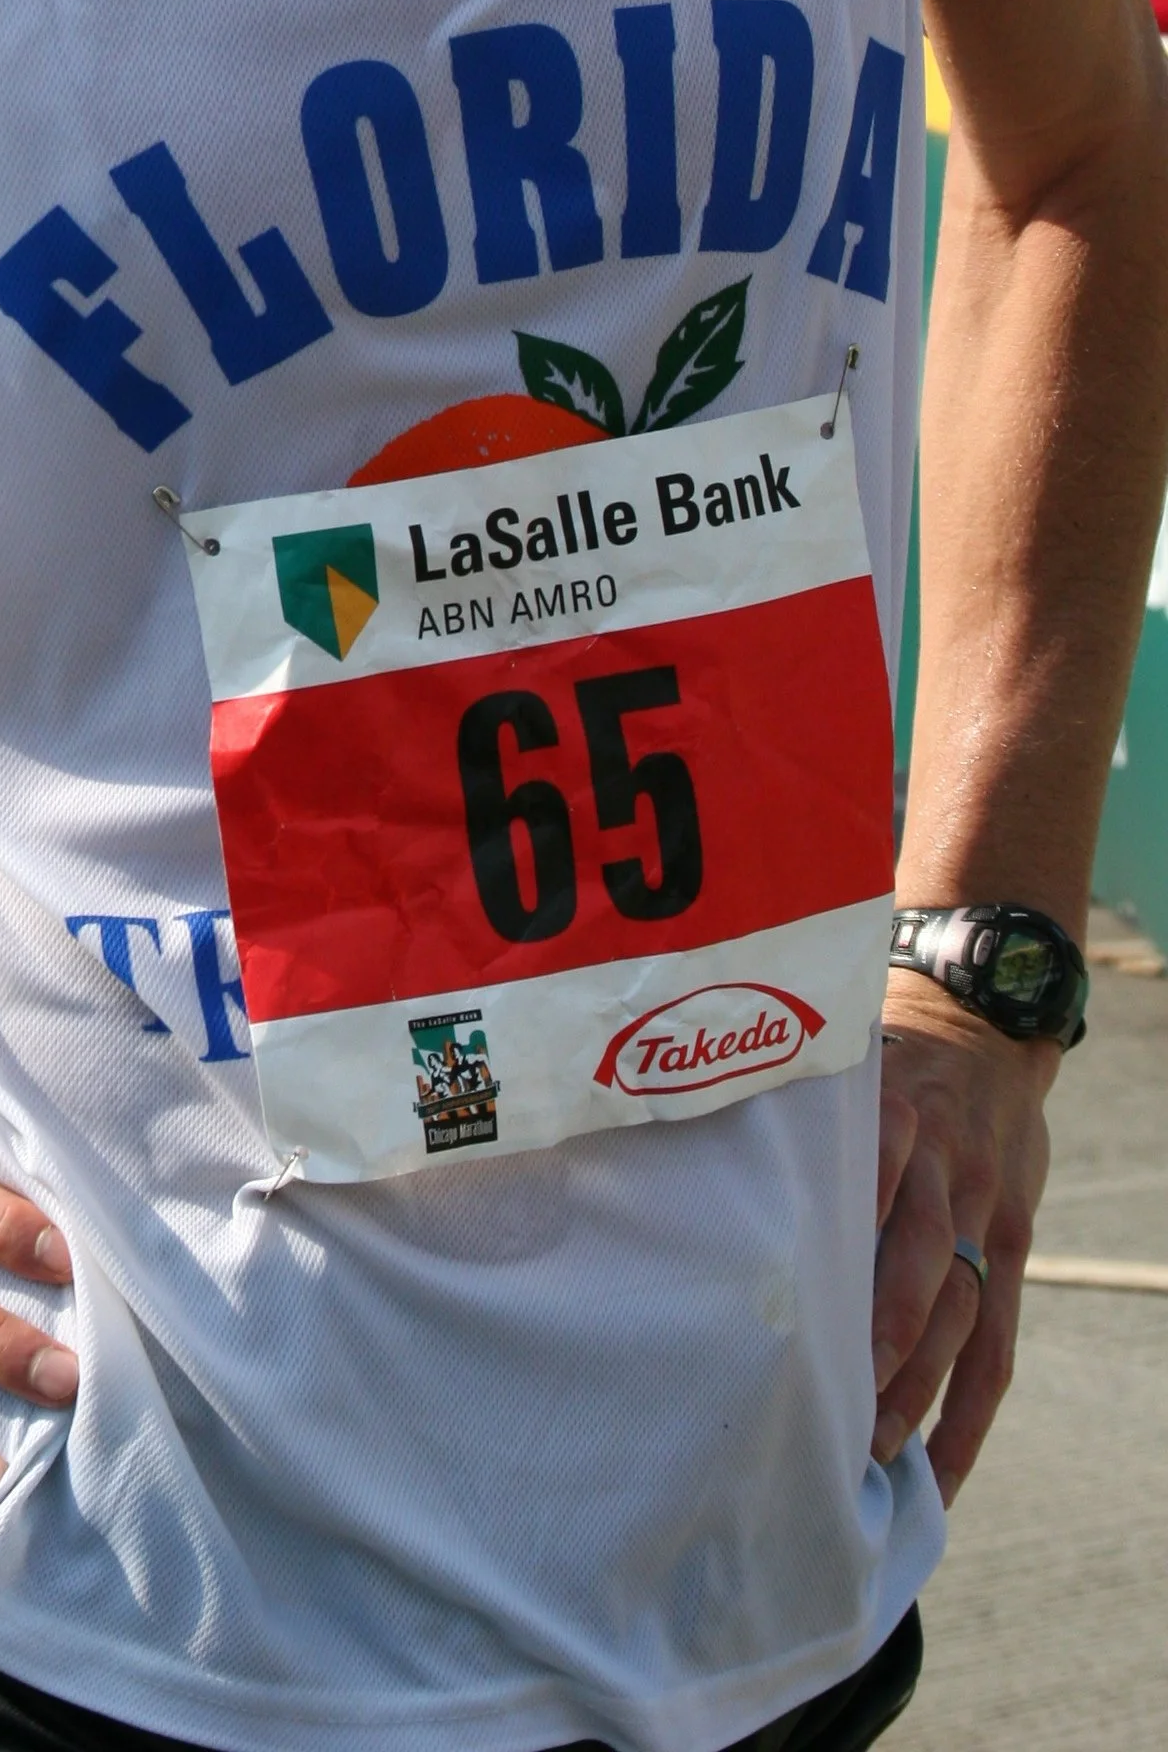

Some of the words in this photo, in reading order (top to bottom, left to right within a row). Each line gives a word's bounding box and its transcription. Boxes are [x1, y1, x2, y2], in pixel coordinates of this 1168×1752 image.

[408, 490, 638, 583] LaSalle
[655, 453, 801, 536] Bank
[418, 597, 494, 639] ABN
[510, 574, 617, 624] AMRO
[457, 664, 704, 944] 65
[636, 1011, 790, 1075] Takeda
[428, 1127, 458, 1145] Chicago
[460, 1119, 494, 1139] Marathon
